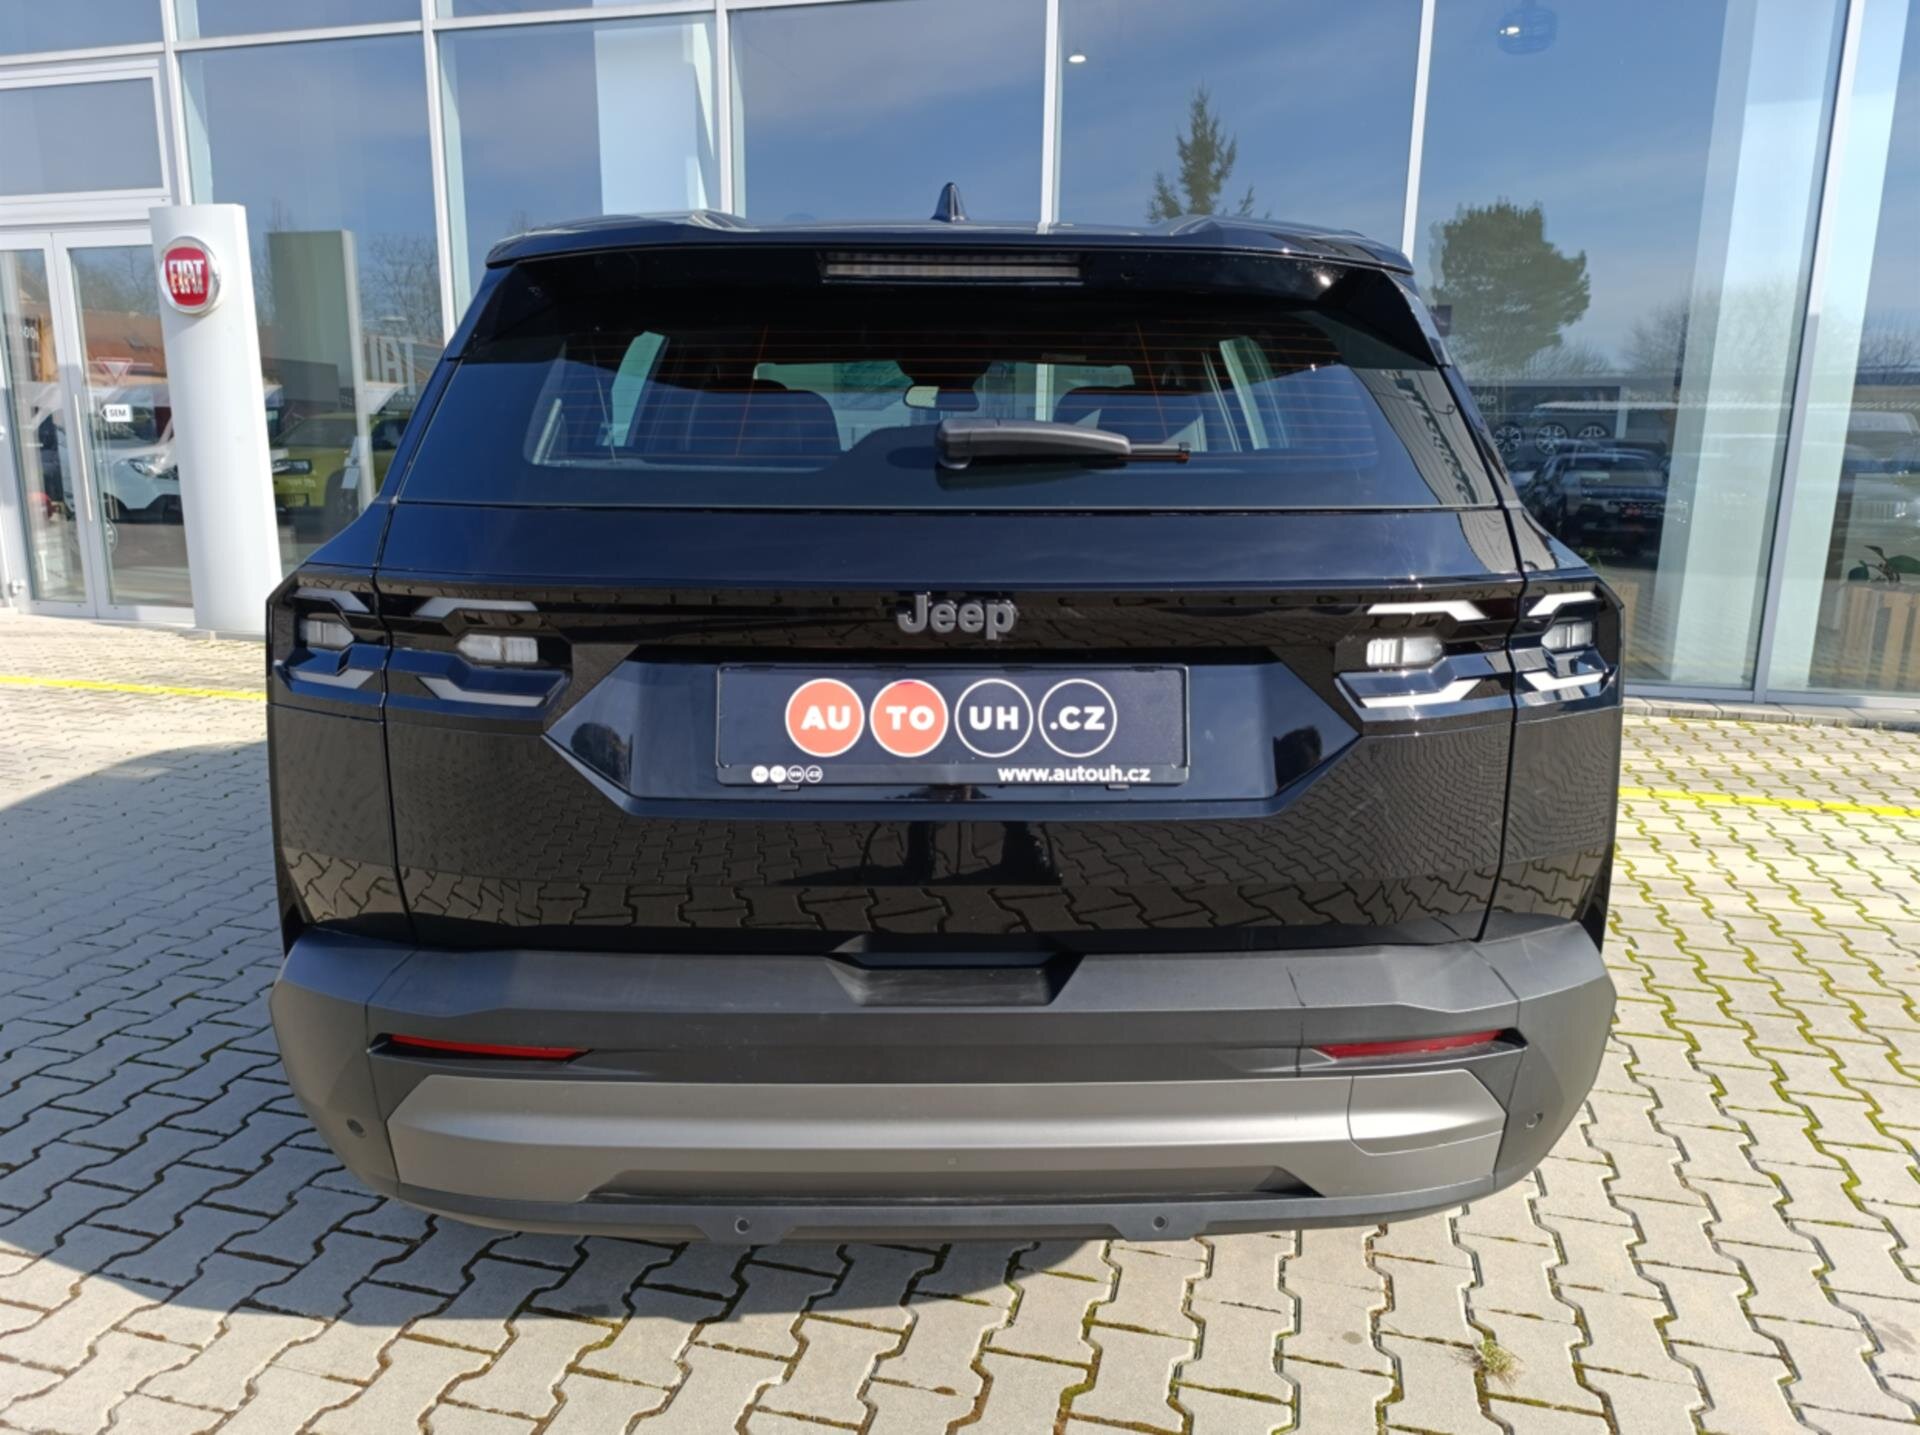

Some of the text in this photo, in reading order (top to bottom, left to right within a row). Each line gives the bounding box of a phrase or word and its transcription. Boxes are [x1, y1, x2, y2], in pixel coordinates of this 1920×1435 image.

[169, 259, 205, 294] FIAT
[897, 592, 1018, 640] Jeep
[800, 705, 1106, 731] AU TO UH .CZ
[997, 764, 1151, 782] www.autouh.cz
